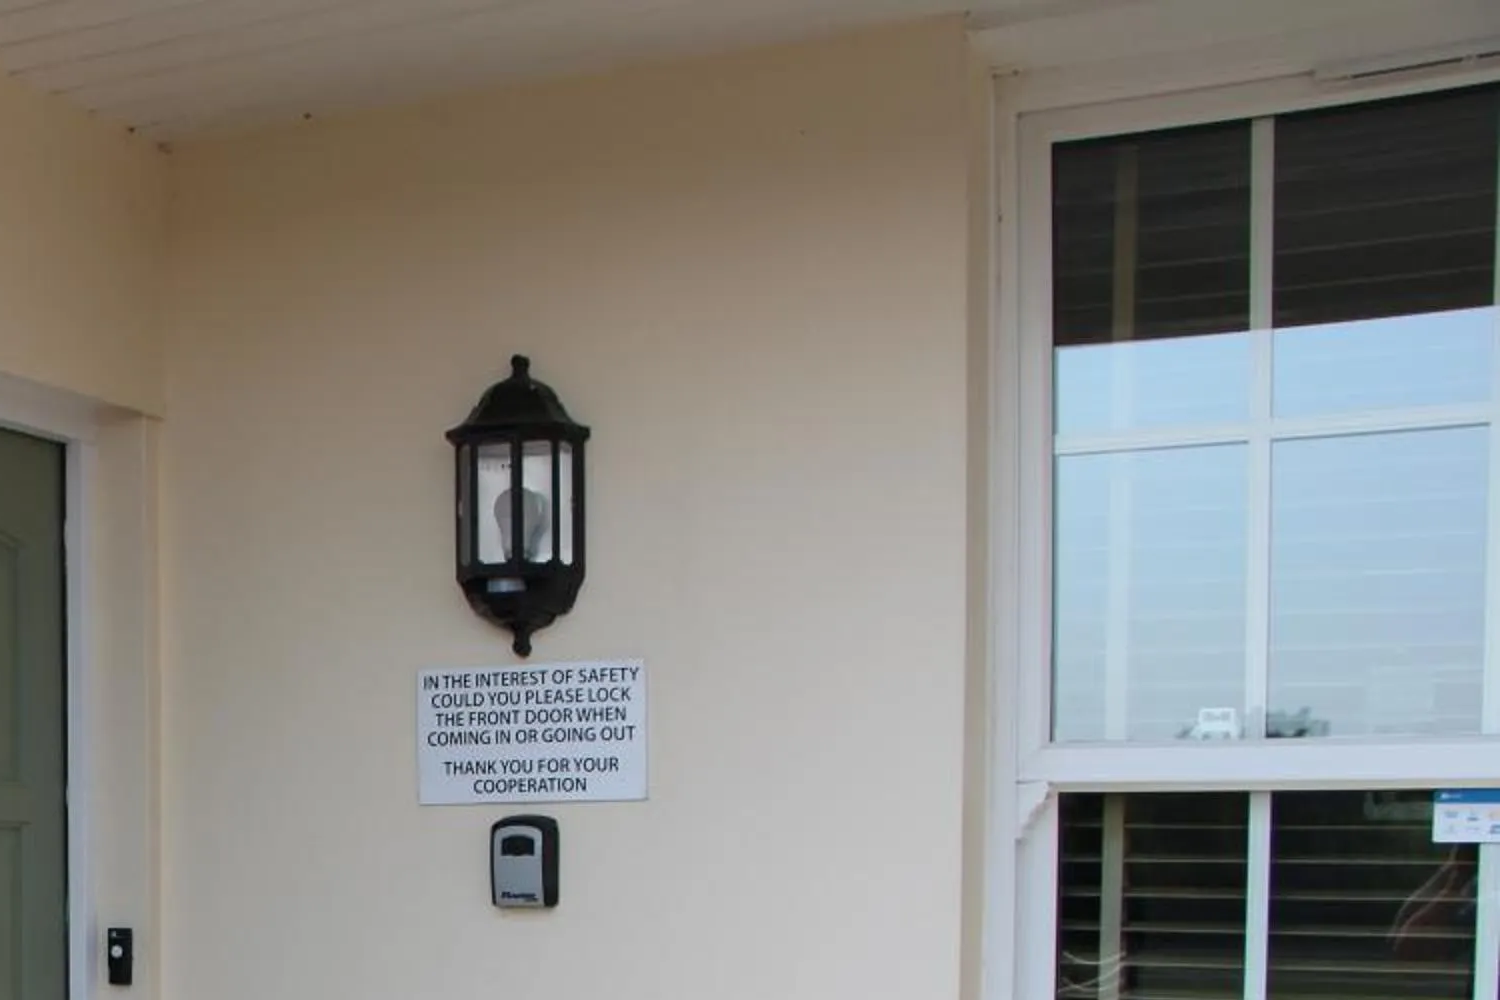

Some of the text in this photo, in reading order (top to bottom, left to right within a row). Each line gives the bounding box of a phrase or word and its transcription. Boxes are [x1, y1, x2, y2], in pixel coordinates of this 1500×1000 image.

[423, 667, 640, 690] IN THE INTEREST OF SAFETY
[431, 687, 632, 709] COULD YOU PLEASE LOCK
[435, 707, 627, 727] THE FRONT DOOR WHEN
[427, 726, 637, 747] COMING IN OR GOING OUT
[443, 757, 619, 776] THANK YOU FOR YOUR
[473, 777, 587, 795] COOPERATION
